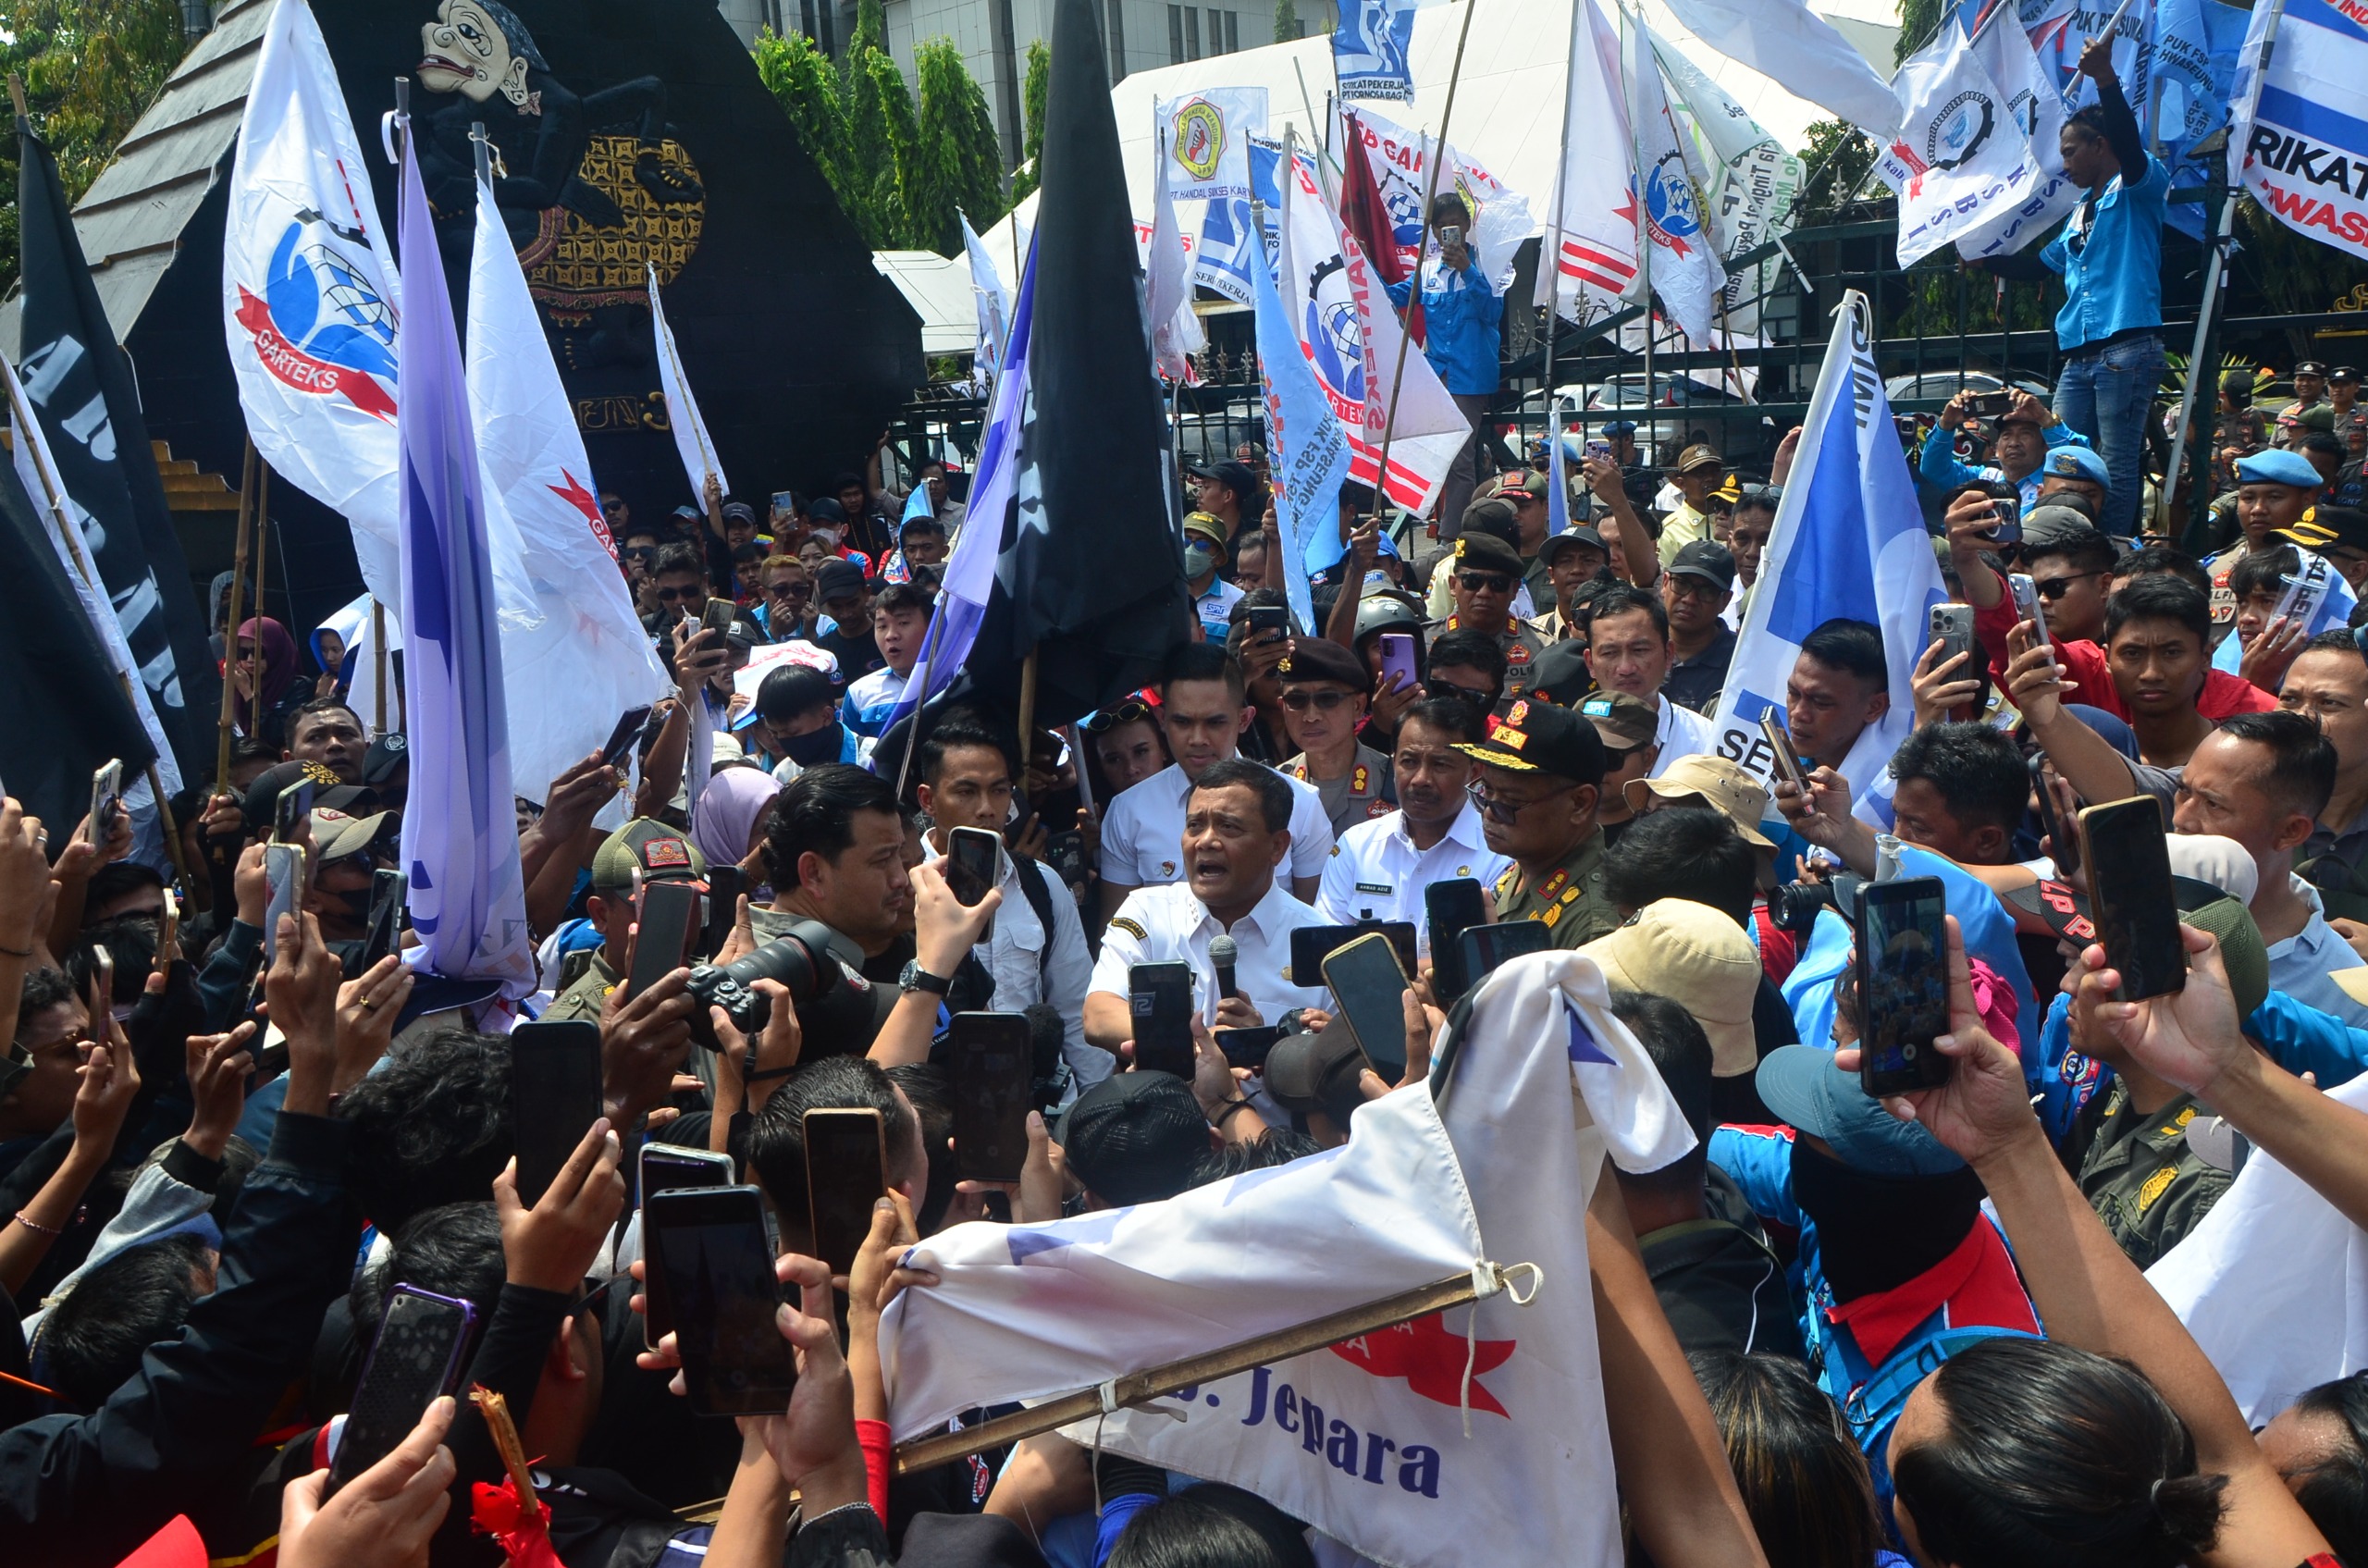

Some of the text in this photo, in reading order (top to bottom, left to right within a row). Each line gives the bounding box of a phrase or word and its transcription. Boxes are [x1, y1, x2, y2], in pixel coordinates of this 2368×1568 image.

[2163, 34, 2192, 55] PUK
[2158, 48, 2214, 93] HWASEUNG
[1368, 80, 1405, 91] PEKERJA
[1179, 188, 1206, 199] HANDAL
[1207, 185, 1228, 197] SUKSES
[255, 329, 339, 389] GARTEKS
[1585, 702, 1610, 714] SPN
[1240, 1366, 1441, 1499] Jepara
